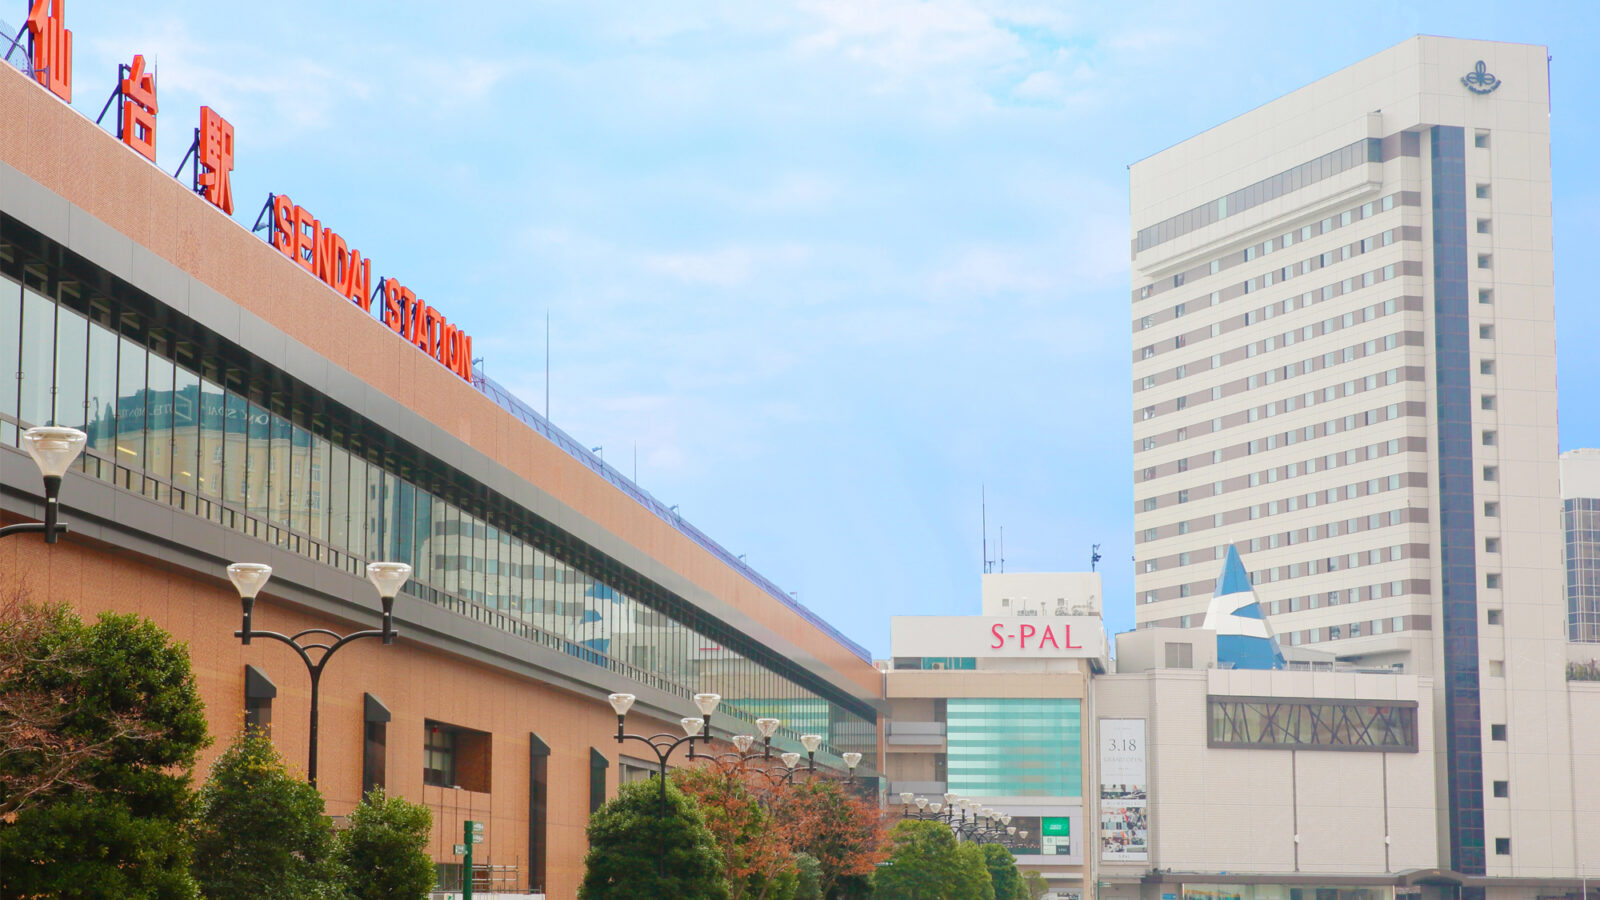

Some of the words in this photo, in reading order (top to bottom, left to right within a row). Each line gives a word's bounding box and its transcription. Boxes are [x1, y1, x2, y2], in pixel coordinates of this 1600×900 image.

[274, 194, 371, 313] SENDAI
[385, 278, 472, 383] STATION
[991, 623, 1082, 649] S-PAL
[1108, 738, 1137, 752] 3.18
